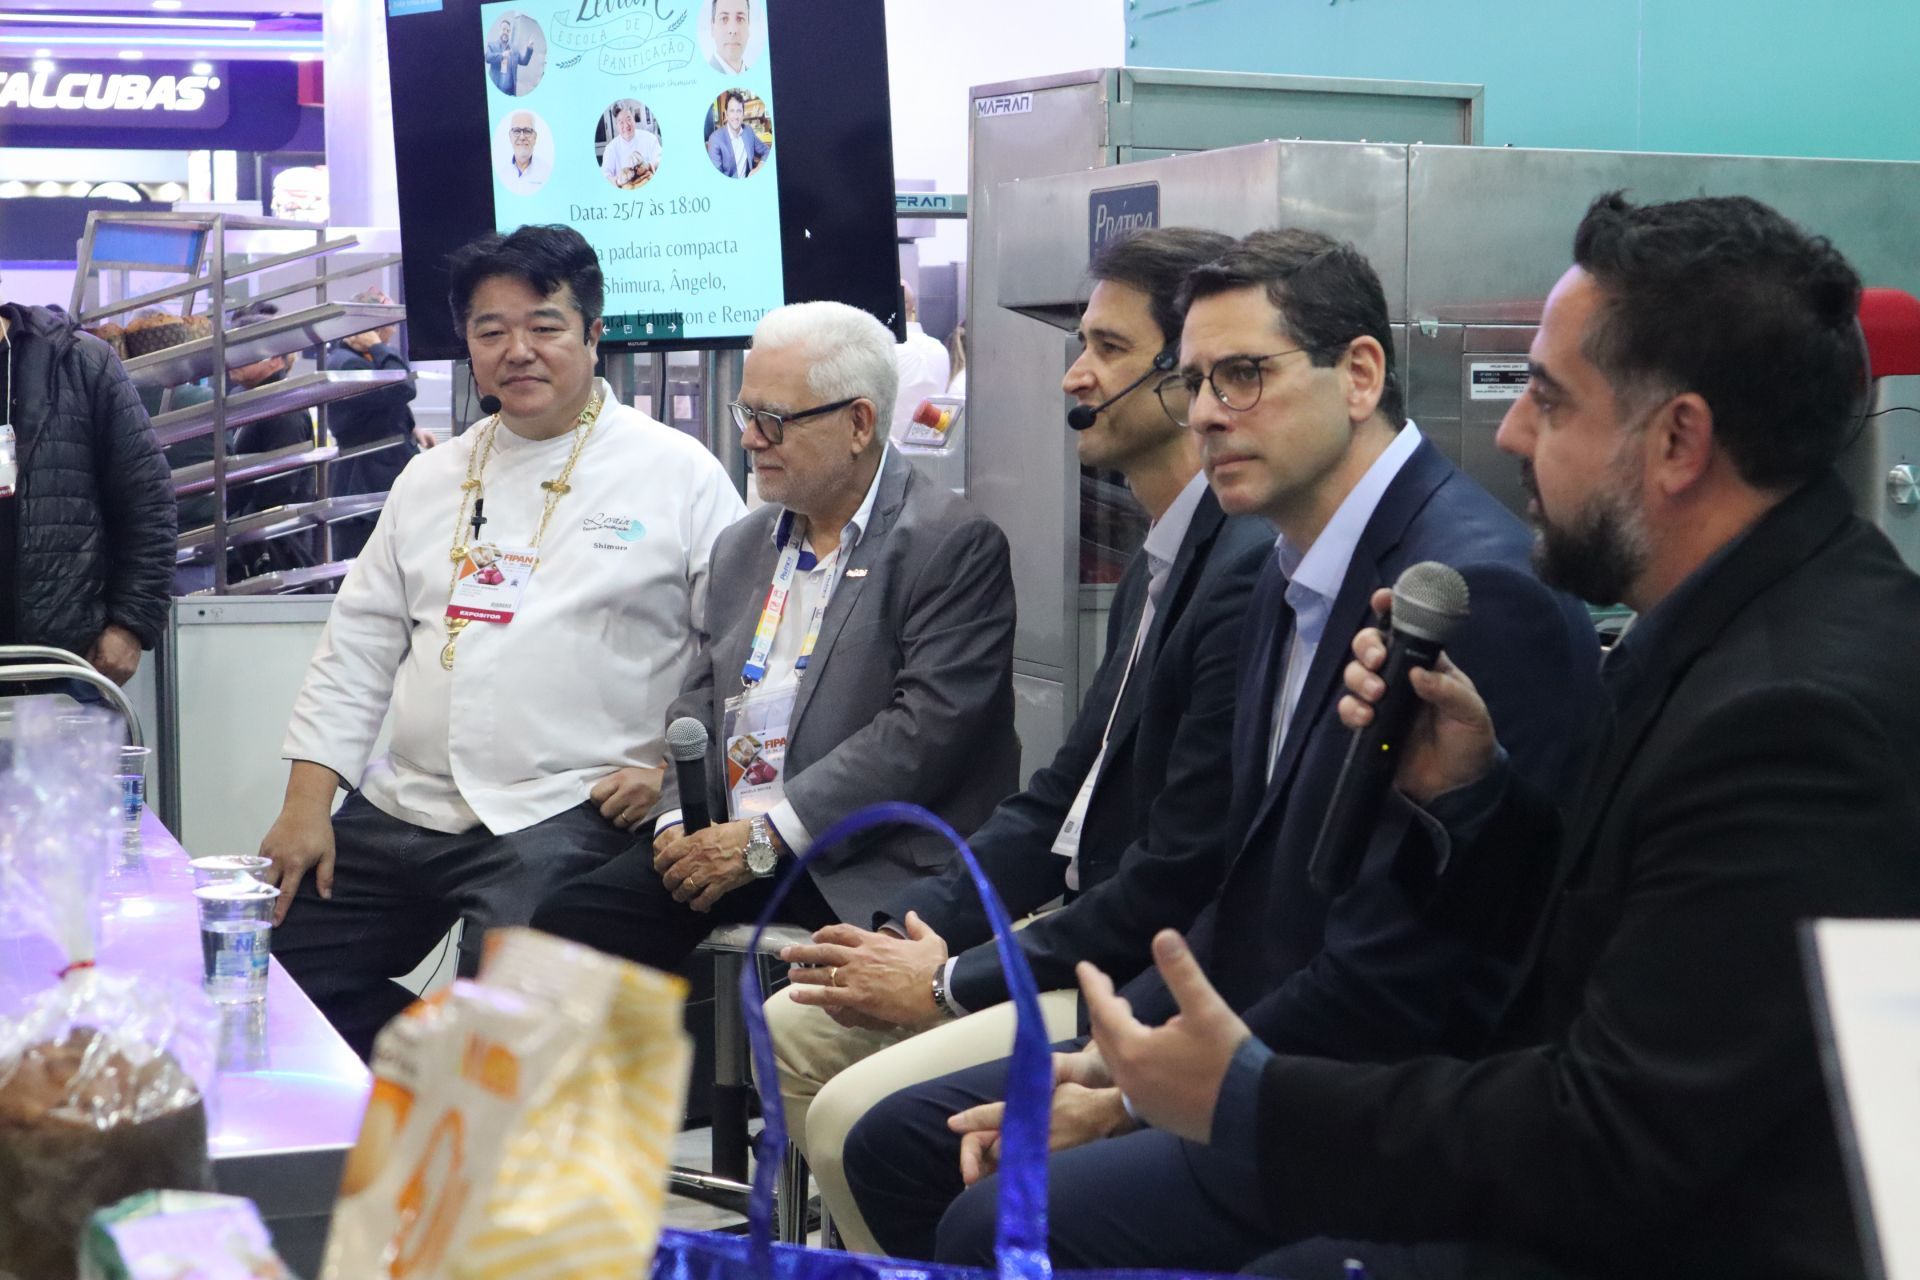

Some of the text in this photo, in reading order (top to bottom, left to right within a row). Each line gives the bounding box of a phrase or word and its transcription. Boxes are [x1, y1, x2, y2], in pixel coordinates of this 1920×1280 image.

[558, 18, 640, 45] ESCOLA DE
[603, 38, 685, 71] PANIFICAÇÃO
[0, 72, 208, 111] ALCUBAS
[977, 96, 1030, 115] MAFRAN
[570, 196, 711, 222] Data: 25/7 às 18:00
[896, 196, 946, 207] FRAN
[609, 243, 661, 265] padaria
[665, 240, 738, 260] compacta
[603, 269, 727, 295] Shimura, Ângelo,
[637, 307, 703, 327] Edmilson
[708, 311, 717, 324] e
[722, 305, 770, 323] Renat
[593, 542, 628, 551] Shimura
[503, 553, 534, 564] FIPAN
[460, 610, 501, 620] EXPOSITOR
[764, 737, 786, 750] FIPA
